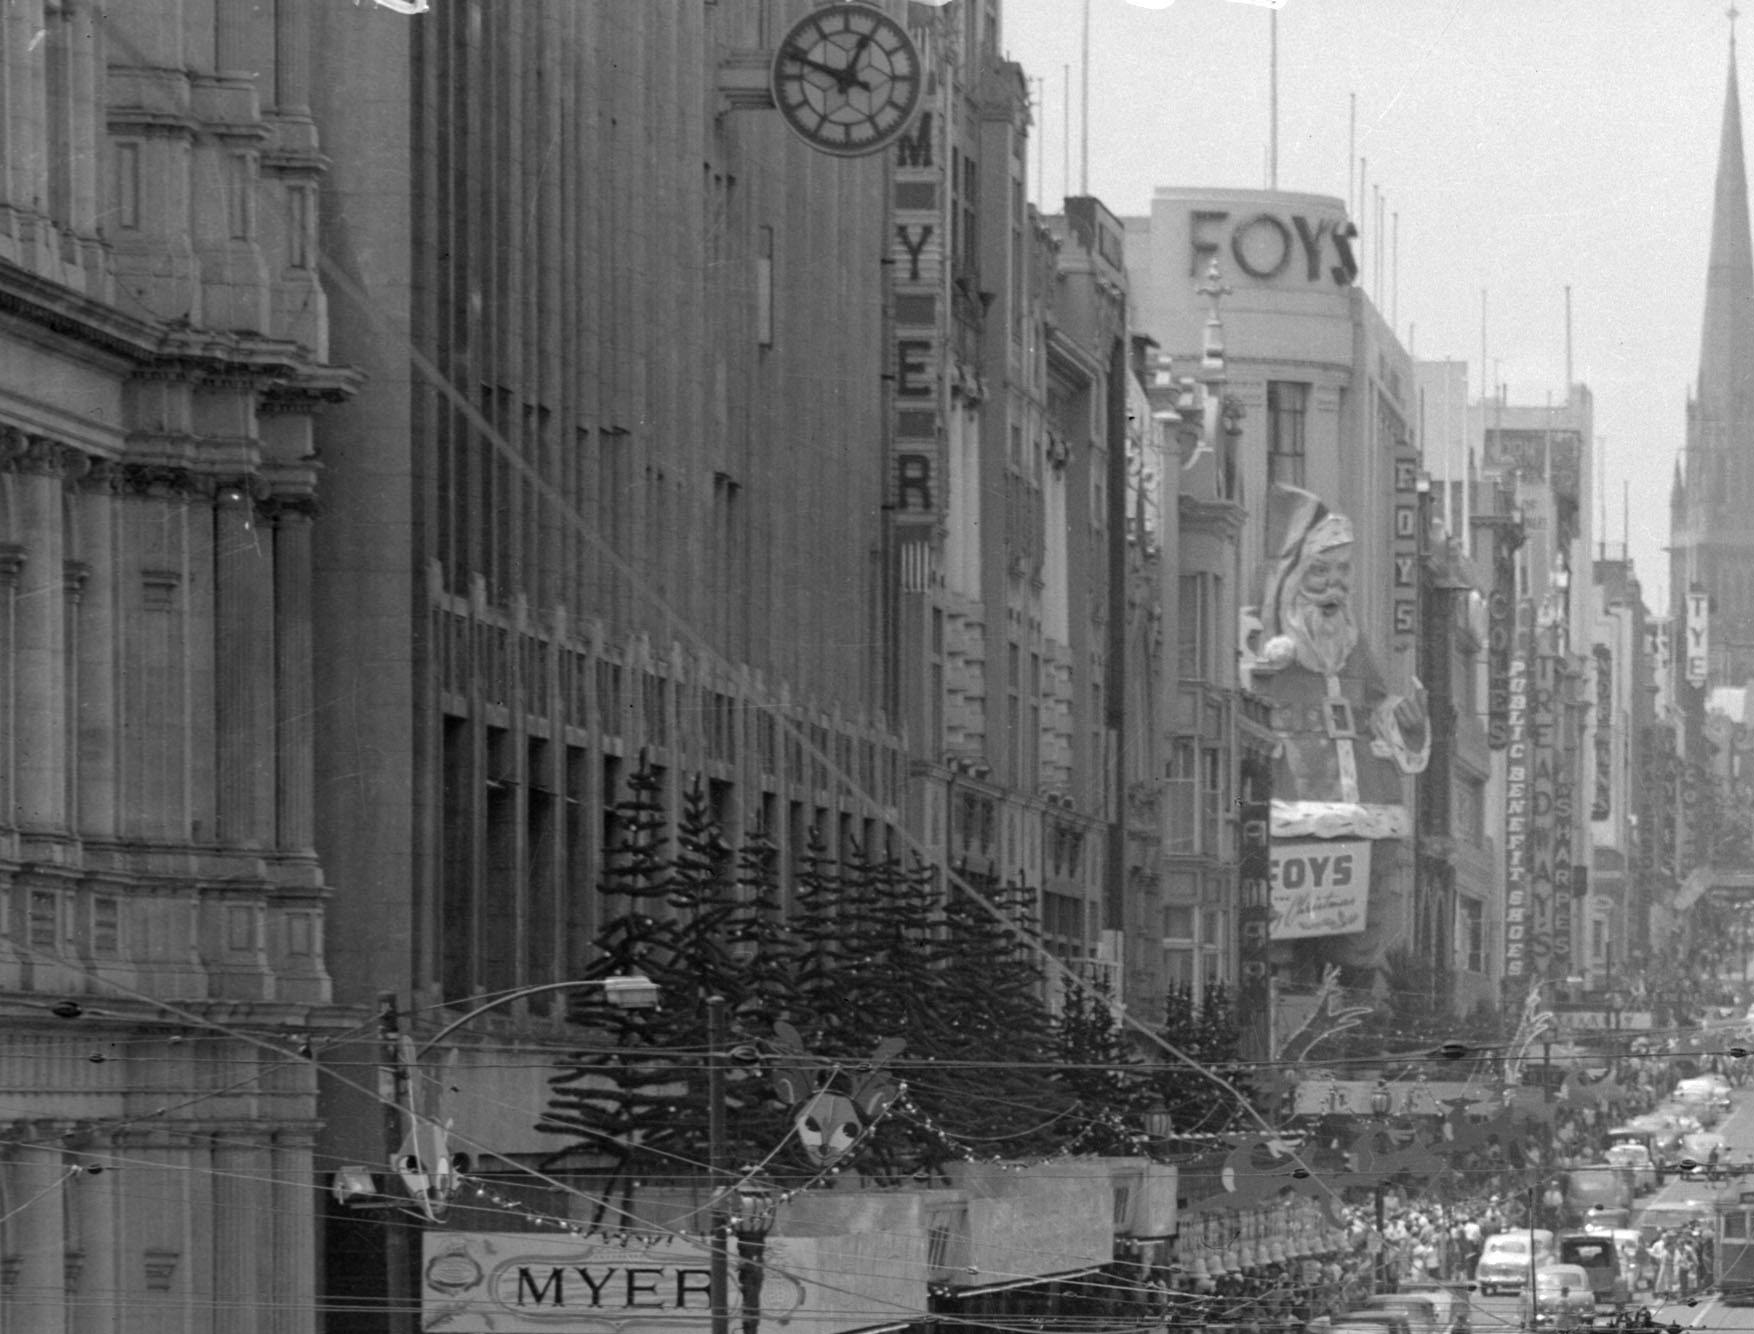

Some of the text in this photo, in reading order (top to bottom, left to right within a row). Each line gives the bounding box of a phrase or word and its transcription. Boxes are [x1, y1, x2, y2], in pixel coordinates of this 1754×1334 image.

[893, 111, 936, 511] MYER
[1396, 458, 1416, 635] FOYS
[1507, 660, 1527, 976] PUBLIC BENEFIT SHOES
[516, 1266, 711, 1309] MYER
